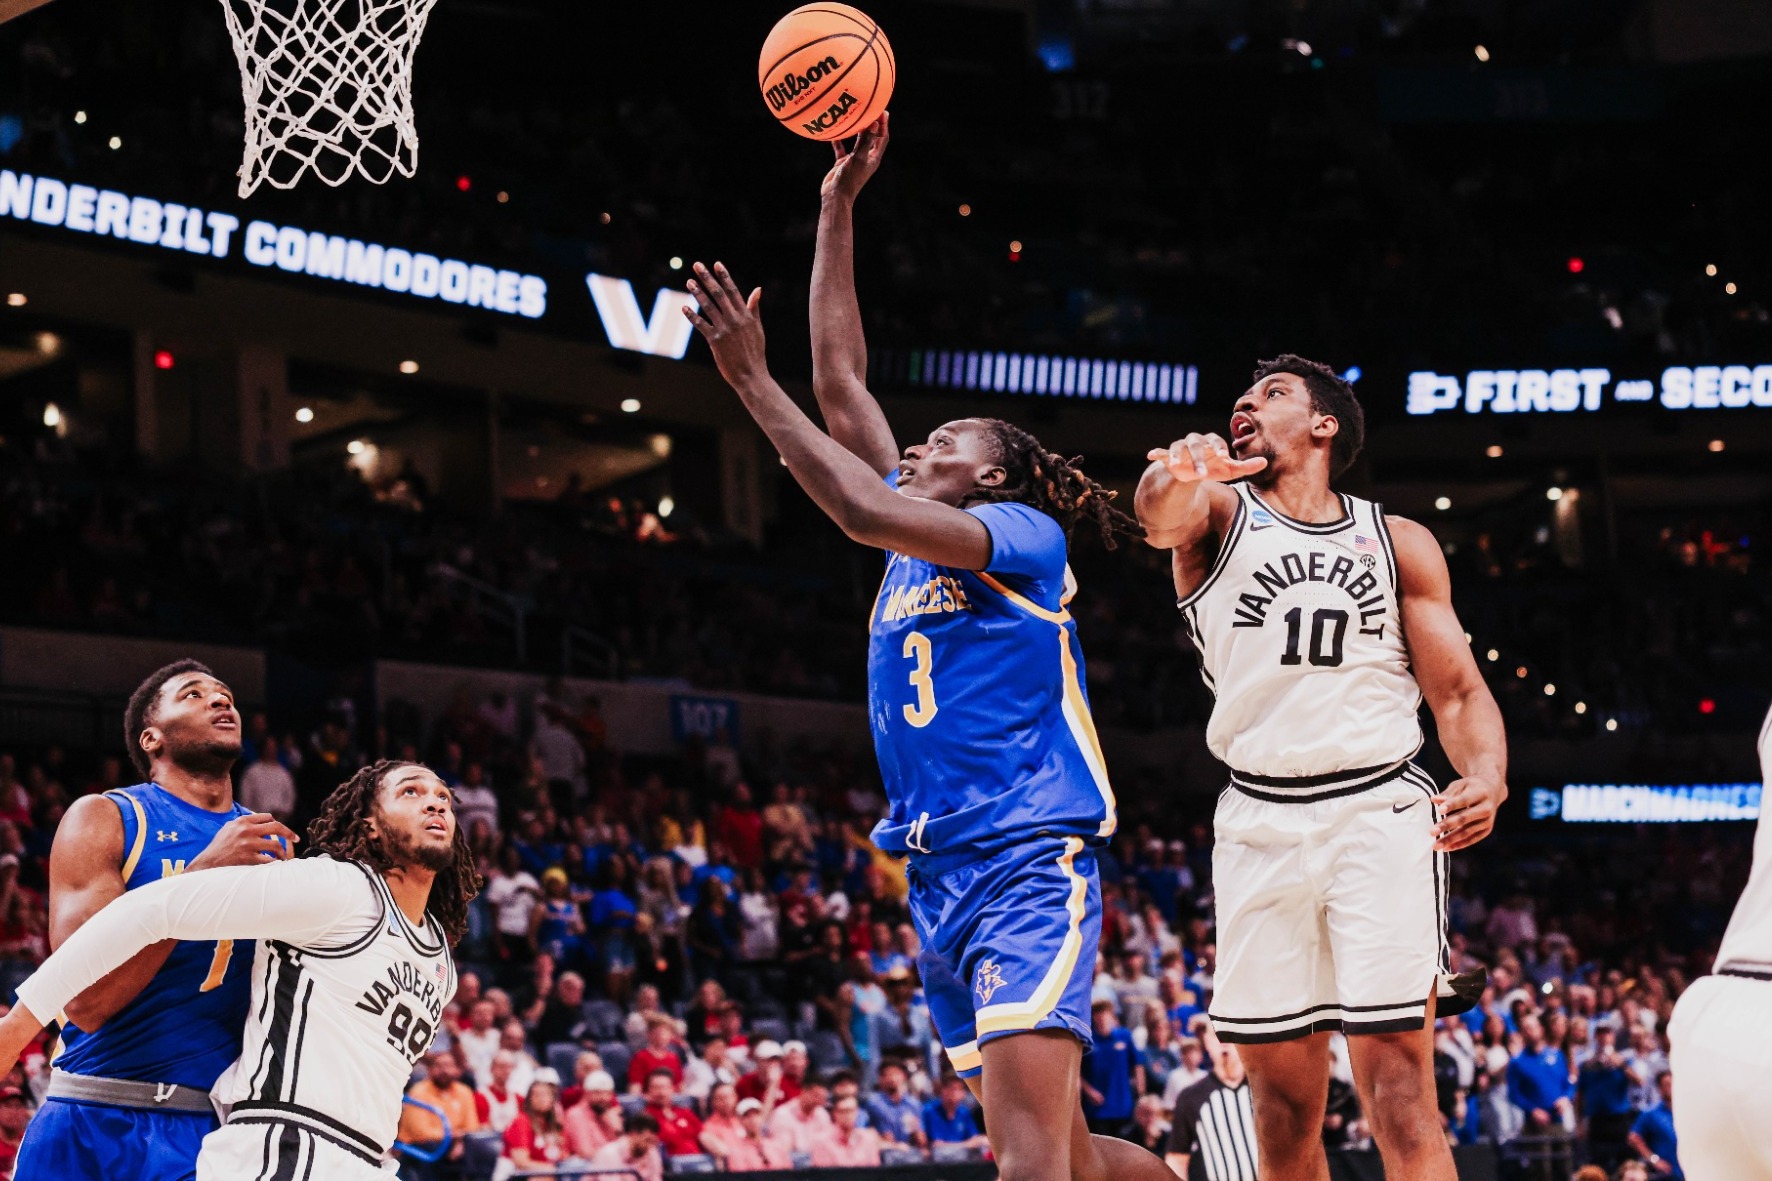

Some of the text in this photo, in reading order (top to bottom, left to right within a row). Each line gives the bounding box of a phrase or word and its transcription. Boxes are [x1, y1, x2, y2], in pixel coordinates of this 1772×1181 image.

[766, 56, 841, 111] Wilson
[802, 92, 857, 134] NCAA
[0, 169, 547, 318] NDERBILT COMMODORES
[1465, 368, 1611, 413] FIRST
[1660, 366, 1772, 409] SECO
[1232, 552, 1387, 640] VANDERBILT
[1280, 607, 1349, 667] 10
[903, 631, 938, 728] 3
[355, 961, 441, 1046] VANDERB
